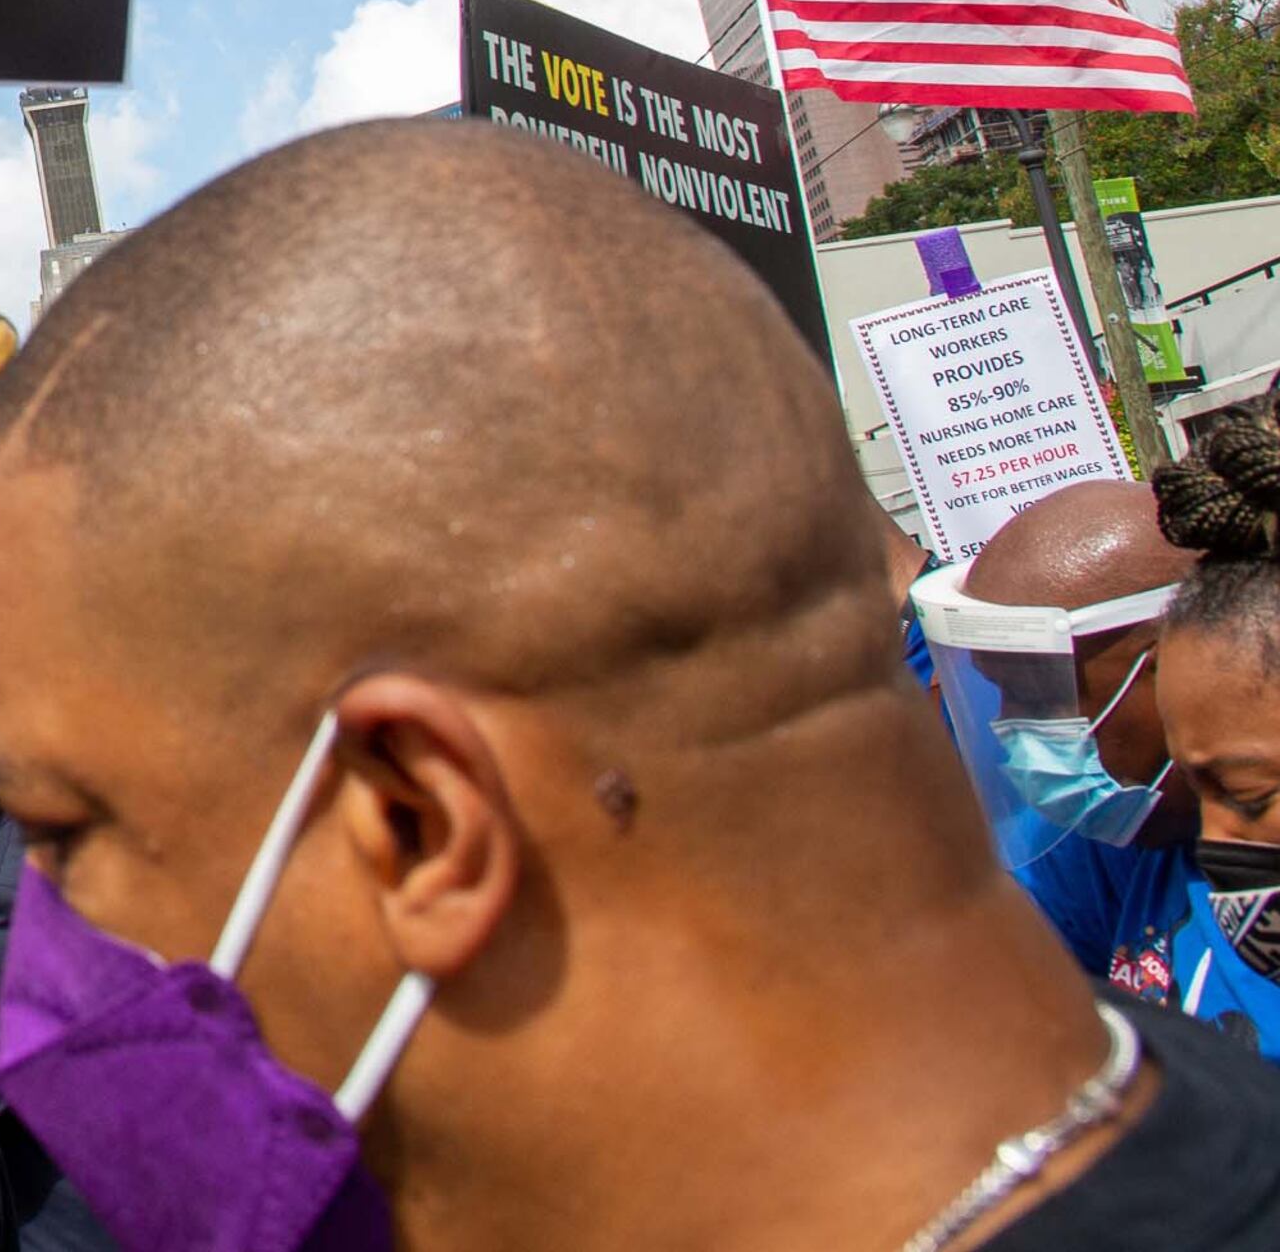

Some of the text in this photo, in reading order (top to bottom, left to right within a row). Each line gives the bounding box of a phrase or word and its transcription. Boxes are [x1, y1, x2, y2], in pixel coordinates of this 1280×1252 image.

[483, 30, 762, 164] THE VOTE IS THE MOST
[639, 152, 791, 234] NONVIOLENT
[890, 297, 1031, 345] LONG-TERM CARE
[929, 328, 1008, 359] WORKERS
[933, 350, 1024, 387] PROVIDES
[948, 379, 1030, 413] 85%-90%
[920, 395, 1076, 445] NURSING HOME CARE
[937, 420, 1076, 466] NEEDS MORE THAN
[944, 462, 1103, 510] VOTE FOR BETTER WAGES
[951, 444, 1079, 488] $7.25 PER HOUR
